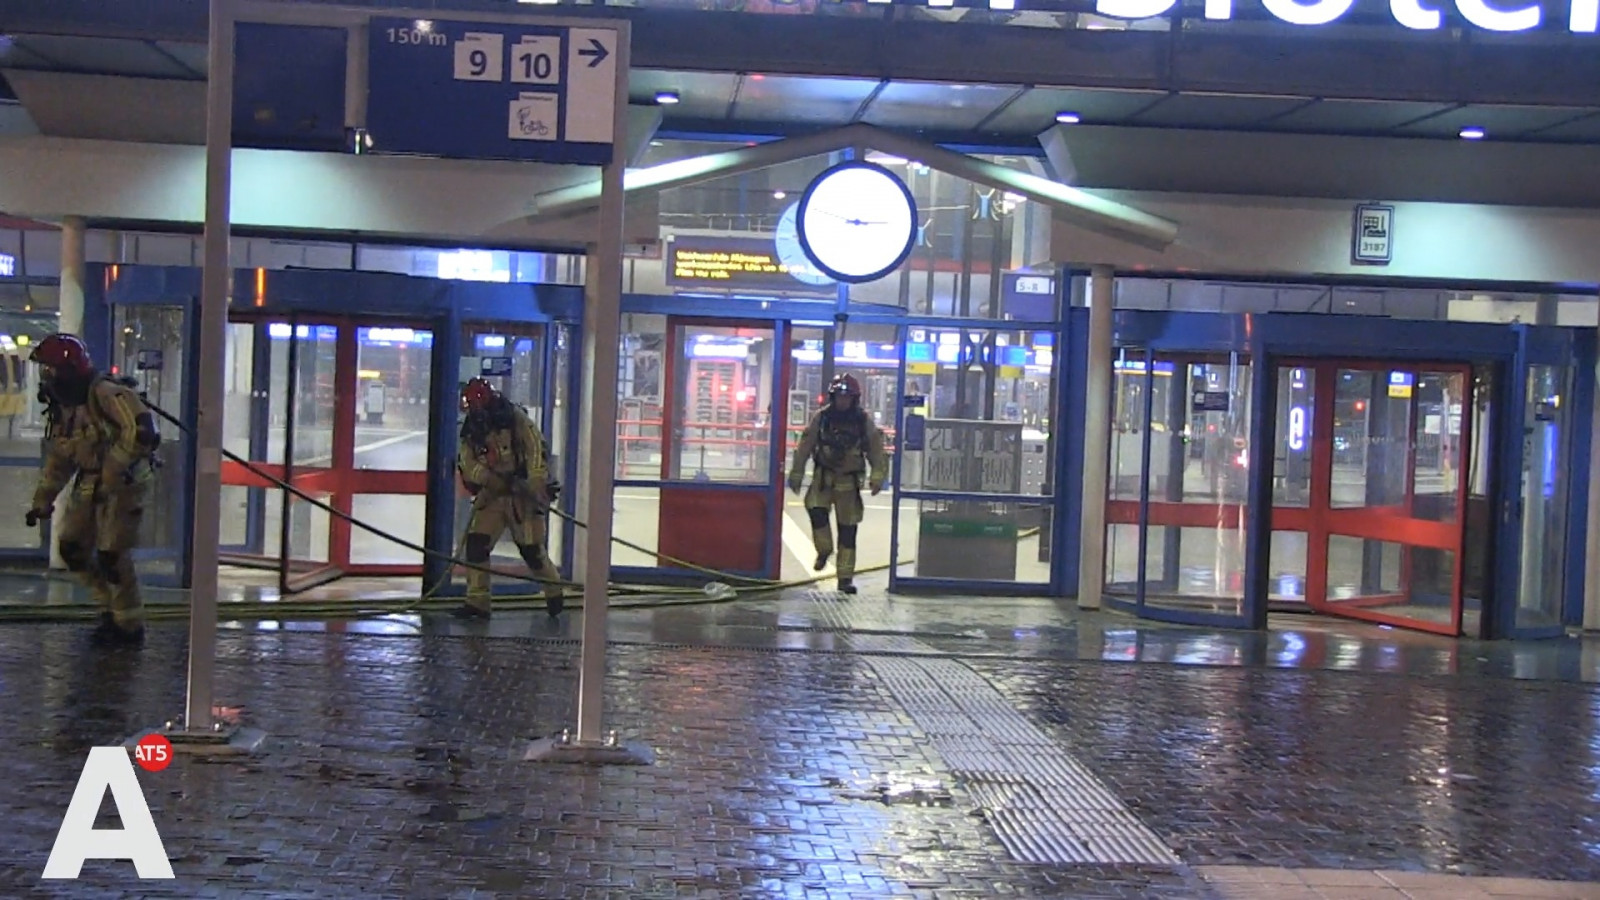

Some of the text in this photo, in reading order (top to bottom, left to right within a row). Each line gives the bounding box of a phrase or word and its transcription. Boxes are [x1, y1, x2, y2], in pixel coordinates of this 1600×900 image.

[386, 28, 447, 46] 150 m
[469, 50, 487, 76] 9
[519, 53, 551, 79] 10
